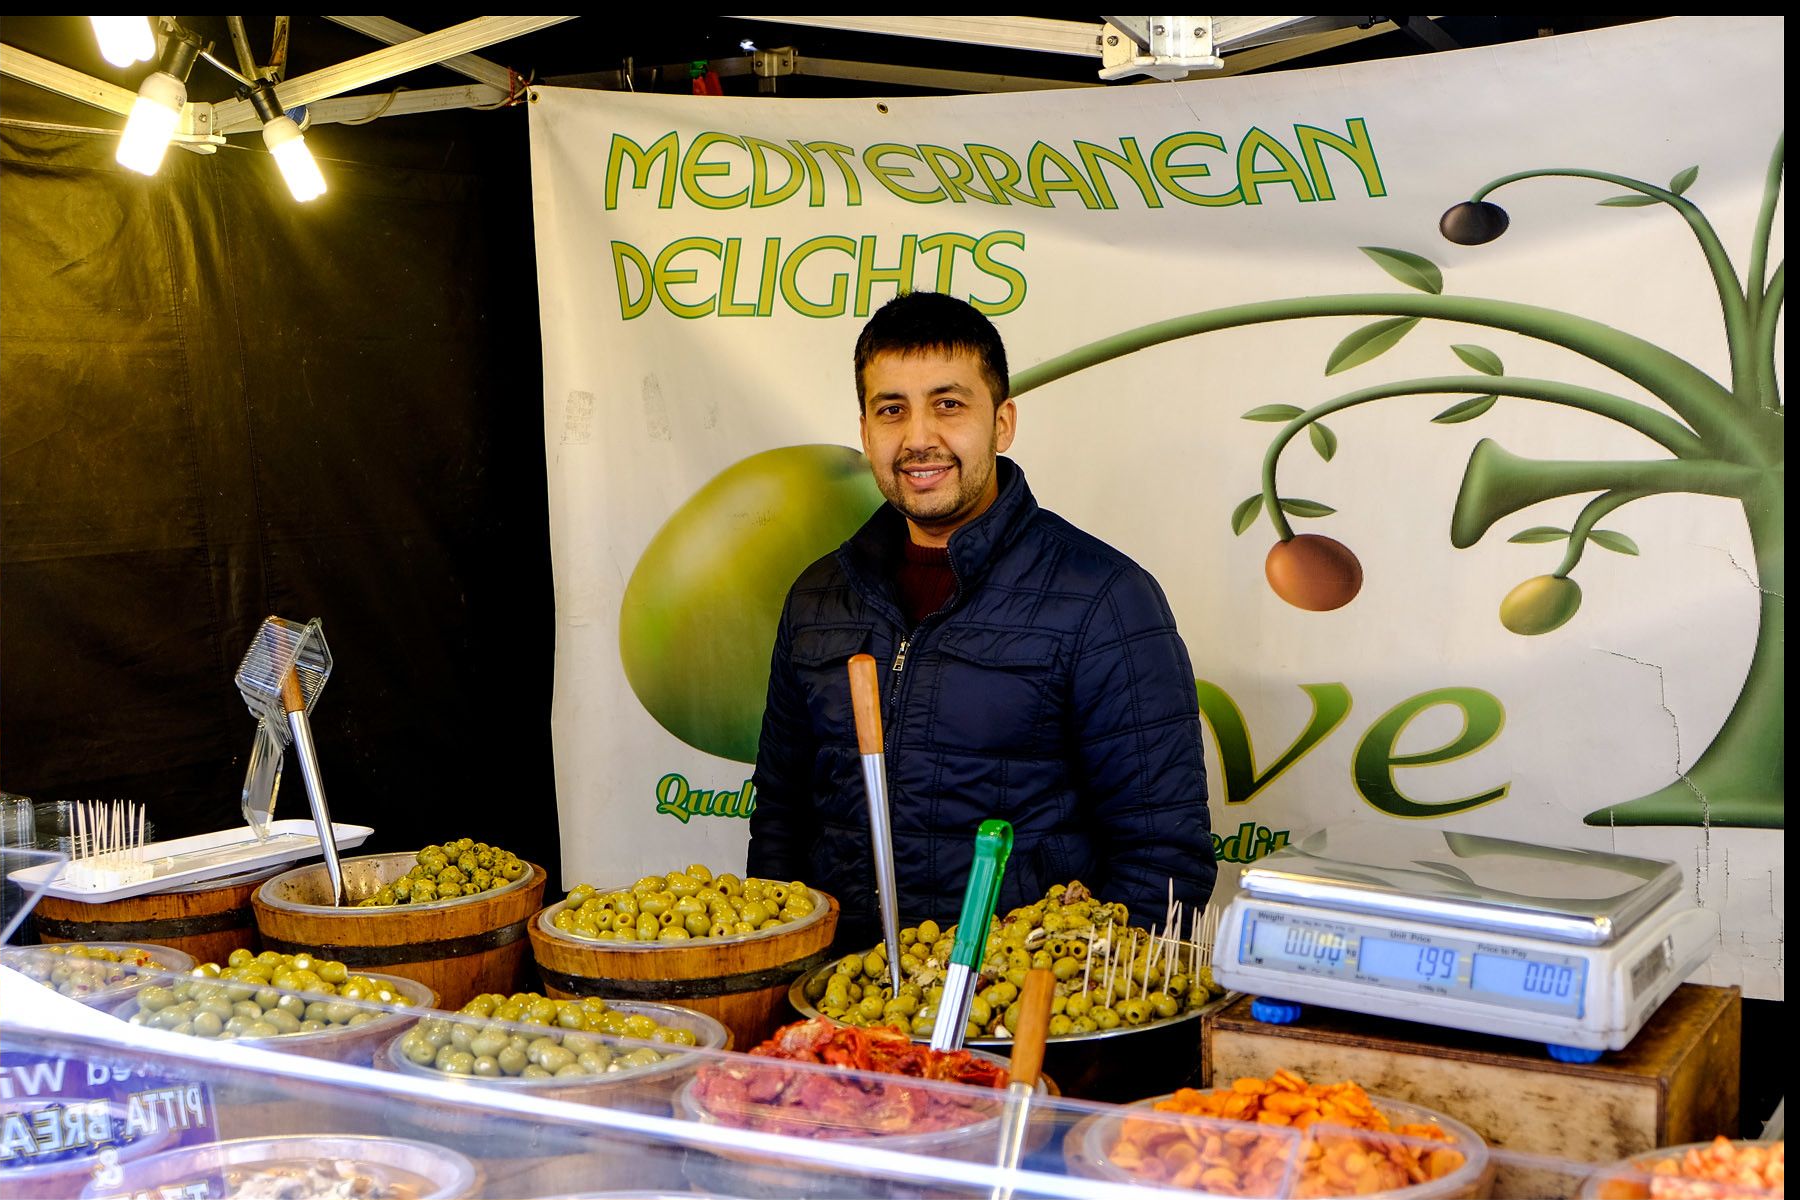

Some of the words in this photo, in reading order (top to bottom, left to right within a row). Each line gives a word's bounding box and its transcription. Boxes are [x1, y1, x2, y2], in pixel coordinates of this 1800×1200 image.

[603, 116, 1389, 211] MEDITERRANEAN
[609, 229, 1029, 321] DELIGHTS
[1258, 911, 1285, 923] Weight
[1390, 930, 1407, 941] Unit
[1410, 932, 1432, 945] Price
[1478, 942, 1499, 955] Price
[1499, 946, 1509, 955] to
[1510, 947, 1528, 960] Pay
[1416, 945, 1456, 979] 1.99
[1522, 960, 1574, 997] 0.00
